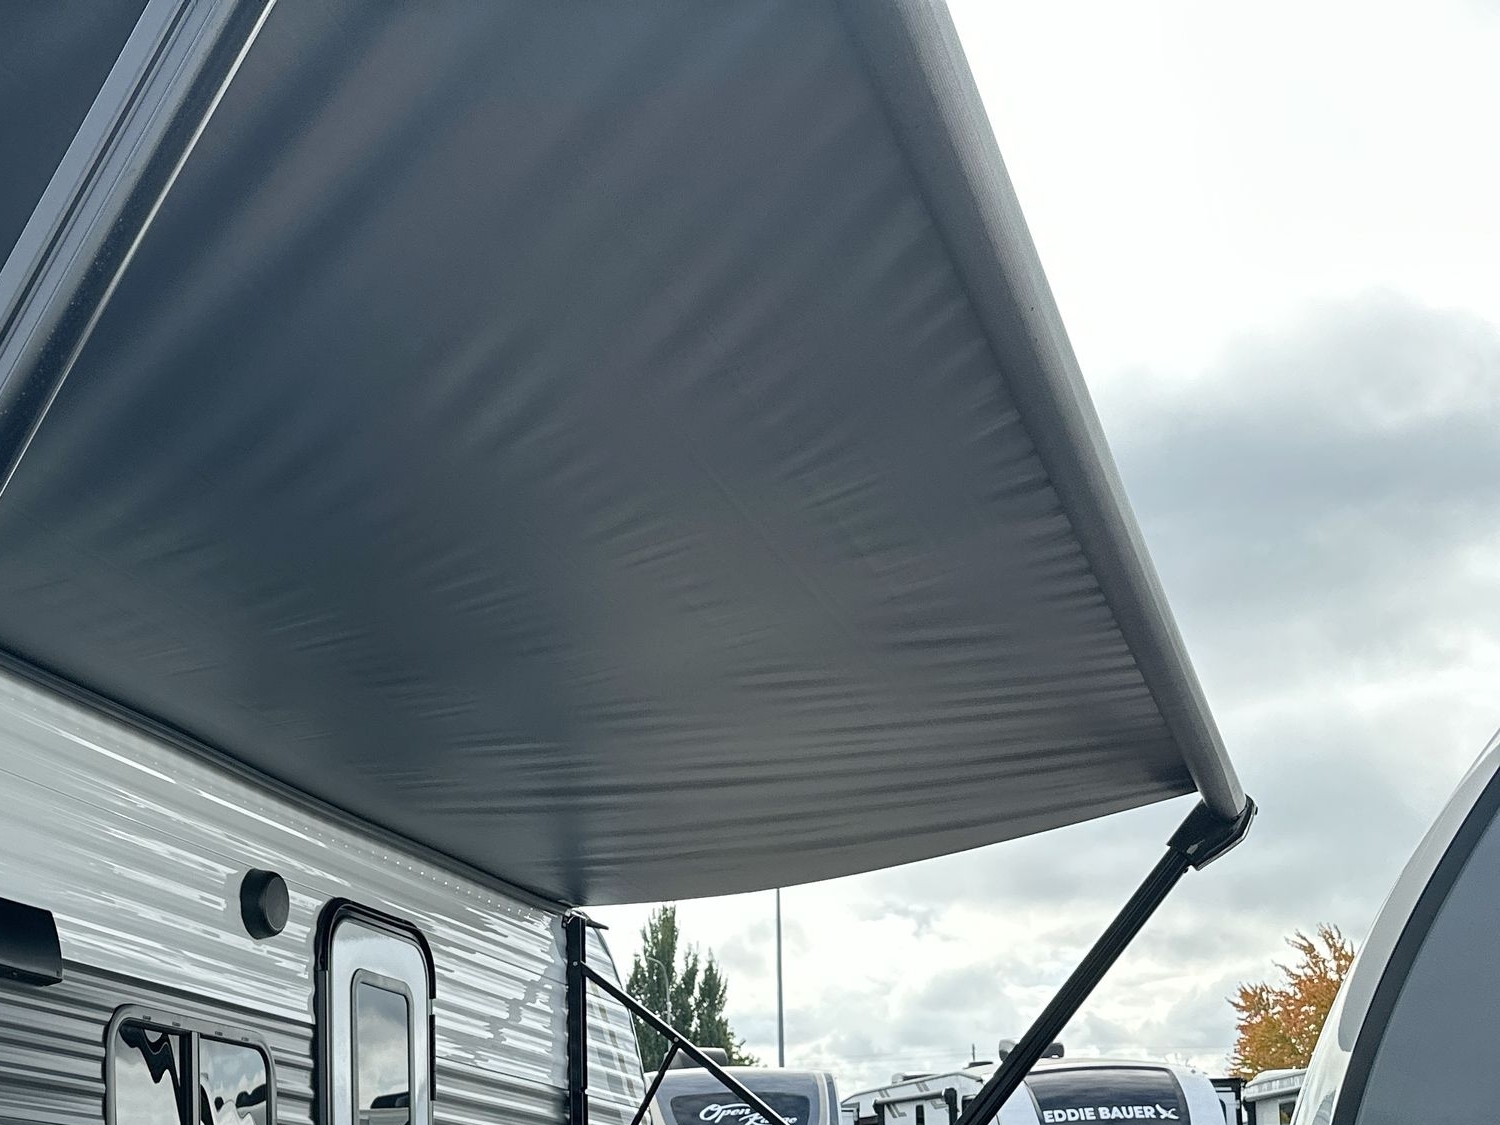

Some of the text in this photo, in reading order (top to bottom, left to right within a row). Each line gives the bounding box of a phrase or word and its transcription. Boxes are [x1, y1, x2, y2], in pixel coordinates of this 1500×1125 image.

[699, 1103, 751, 1124] Open
[1043, 1104, 1156, 1123] EDDIE BAUER
